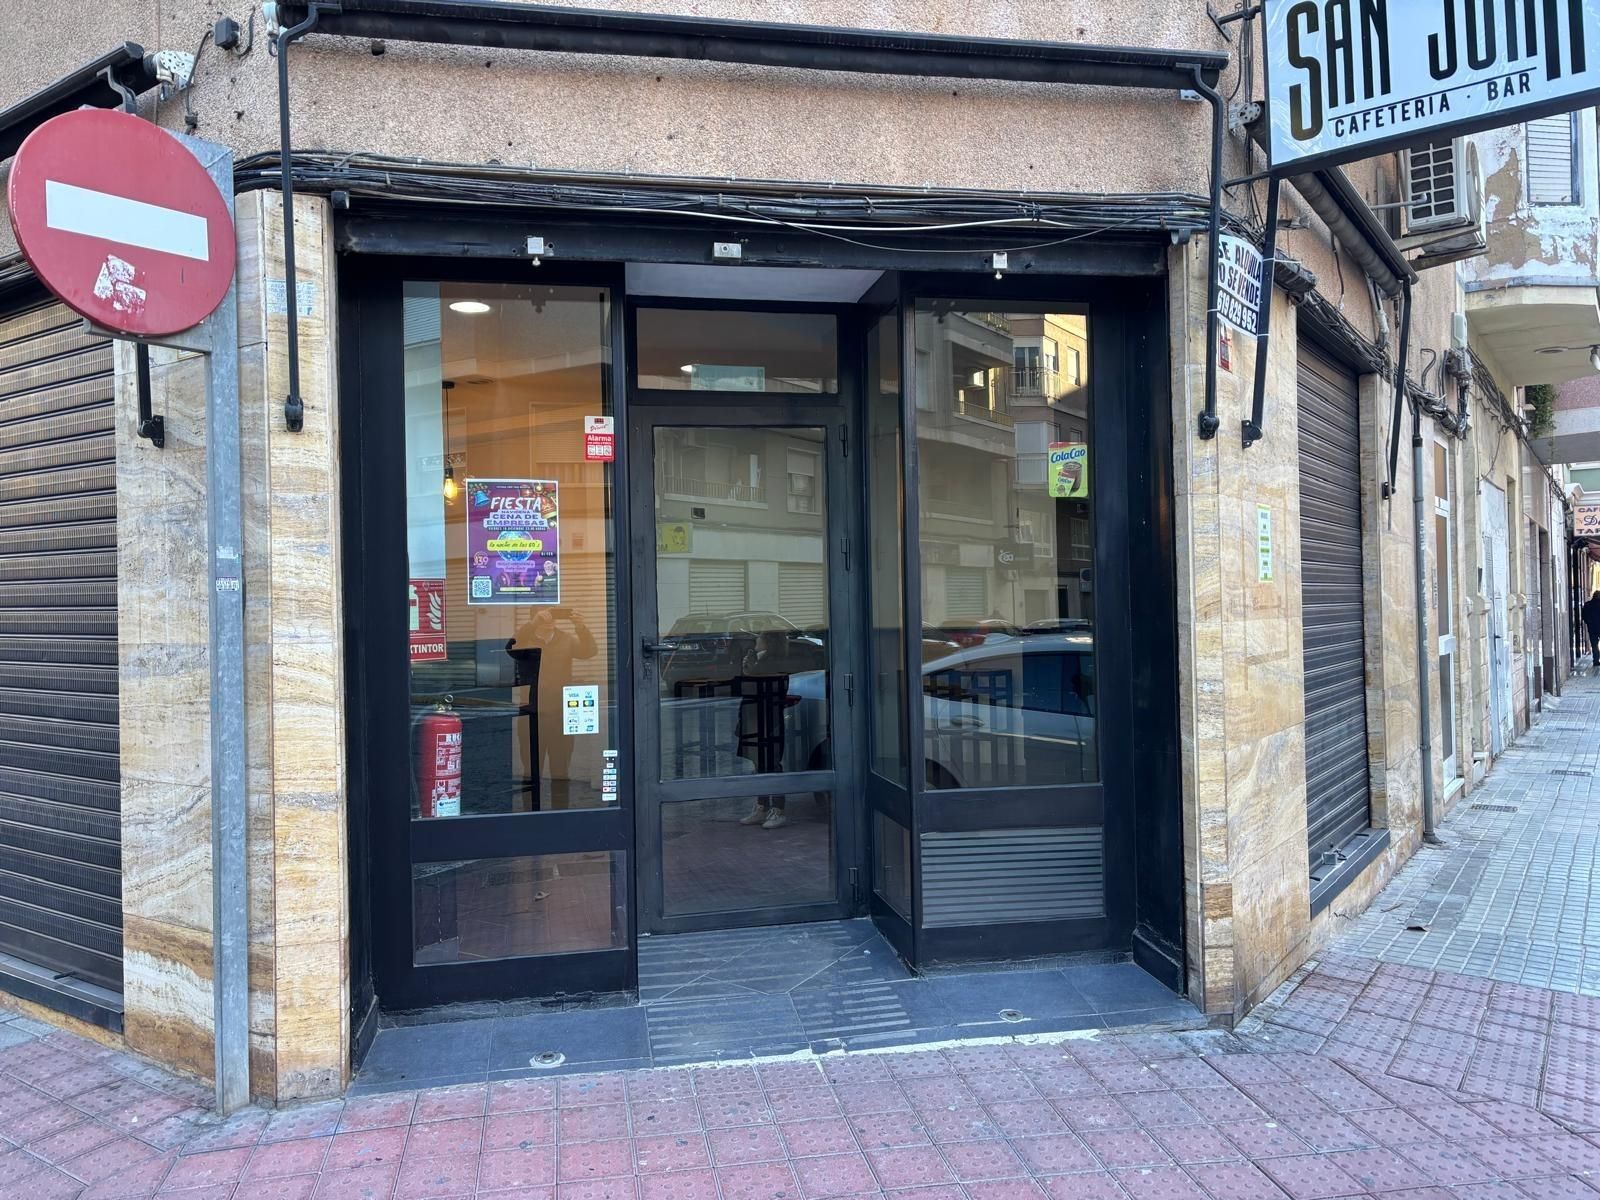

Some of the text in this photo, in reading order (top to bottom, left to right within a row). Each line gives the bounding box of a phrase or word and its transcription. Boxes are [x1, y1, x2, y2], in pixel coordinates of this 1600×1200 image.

[1286, 0, 1391, 141] SAN
[1335, 72, 1531, 138] CAFETERIA BAR
[1234, 244, 1261, 283] ALQUILA
[1227, 266, 1237, 291] SE
[1237, 273, 1260, 307] VENDE
[1217, 290, 1257, 333] 619 829 952
[1051, 448, 1086, 463] ColaCao
[490, 497, 541, 511] FIESTA
